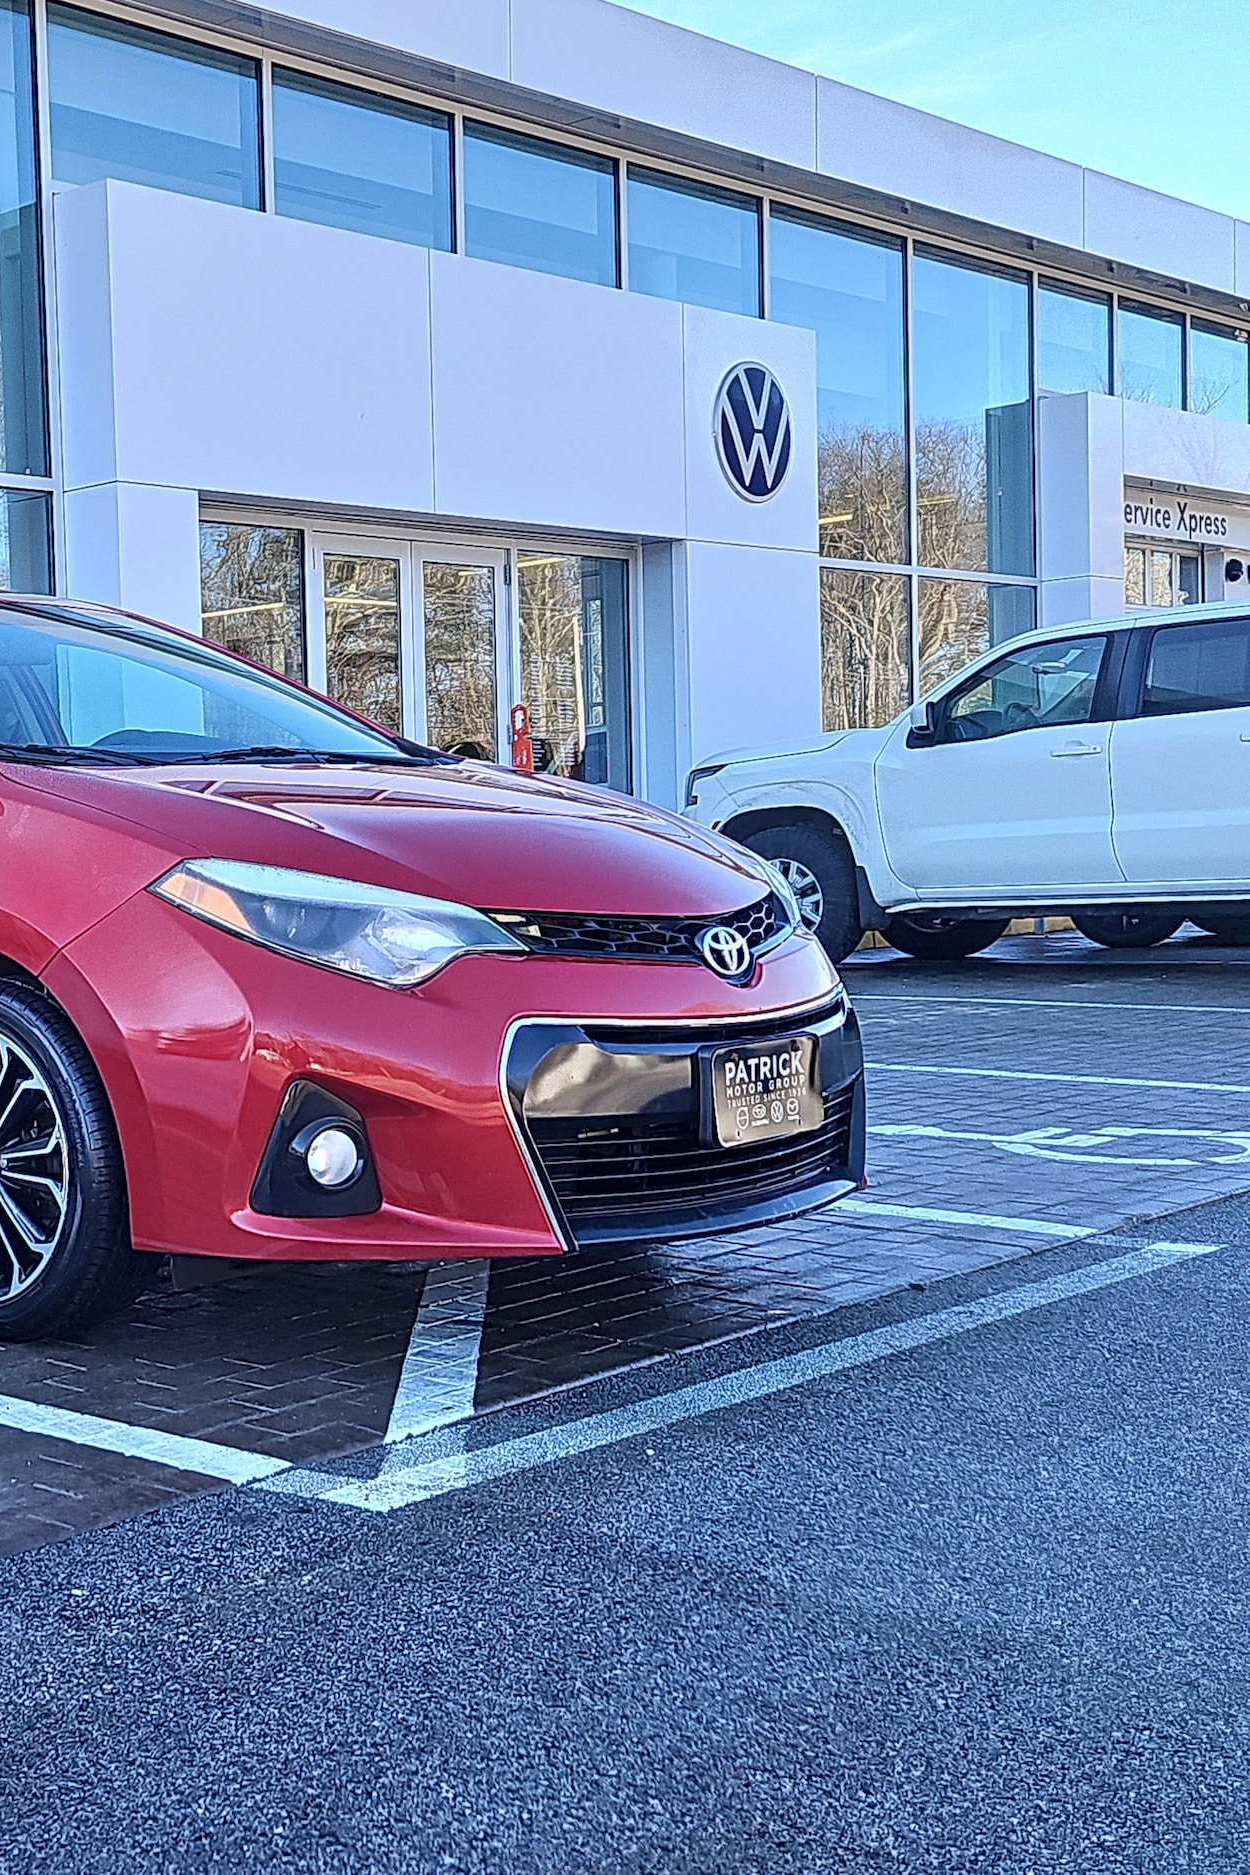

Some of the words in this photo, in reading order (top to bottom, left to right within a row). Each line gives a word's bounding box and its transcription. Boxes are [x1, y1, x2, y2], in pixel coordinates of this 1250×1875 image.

[716, 364, 791, 493] VW
[1124, 498, 1171, 529] ervice
[1177, 502, 1228, 539] Xpress
[724, 1050, 805, 1086] PATRICK
[726, 1081, 763, 1098] MOTOR
[768, 1075, 806, 1091] GROUP
[727, 1094, 760, 1109] TRUSTED
[763, 1090, 786, 1103] SINCE
